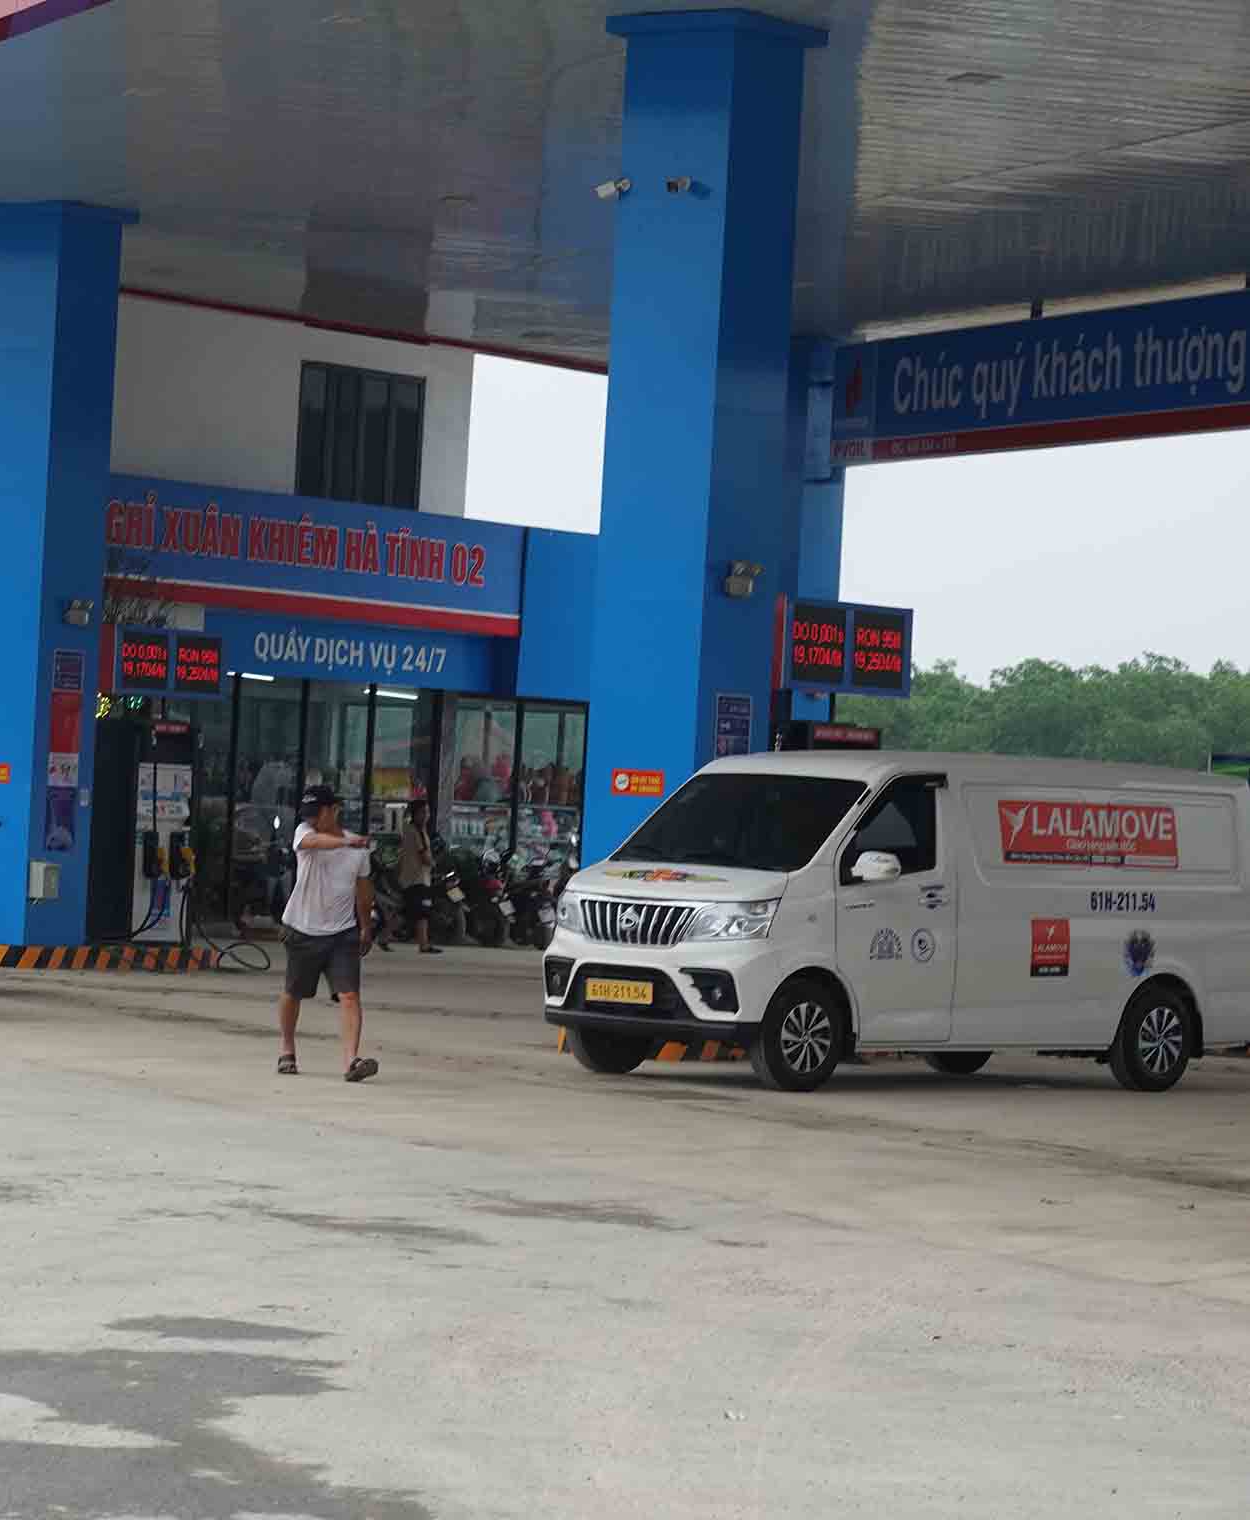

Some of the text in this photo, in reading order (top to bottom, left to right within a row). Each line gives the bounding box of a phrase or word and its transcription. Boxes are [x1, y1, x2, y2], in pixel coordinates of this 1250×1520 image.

[893, 325, 1247, 420] Chúc quý khách thượng
[160, 503, 242, 558] XUÂN
[247, 512, 339, 570] KHIÊM
[345, 521, 380, 575] HÀ
[386, 528, 447, 583] TĨNH
[452, 544, 486, 587] 02
[314, 638, 364, 671] DỊCH
[369, 642, 397, 676] VỤ
[401, 645, 447, 673] 24/7
[1032, 807, 1173, 841] LALAMOVE
[1091, 891, 1156, 912] 61H-211.54
